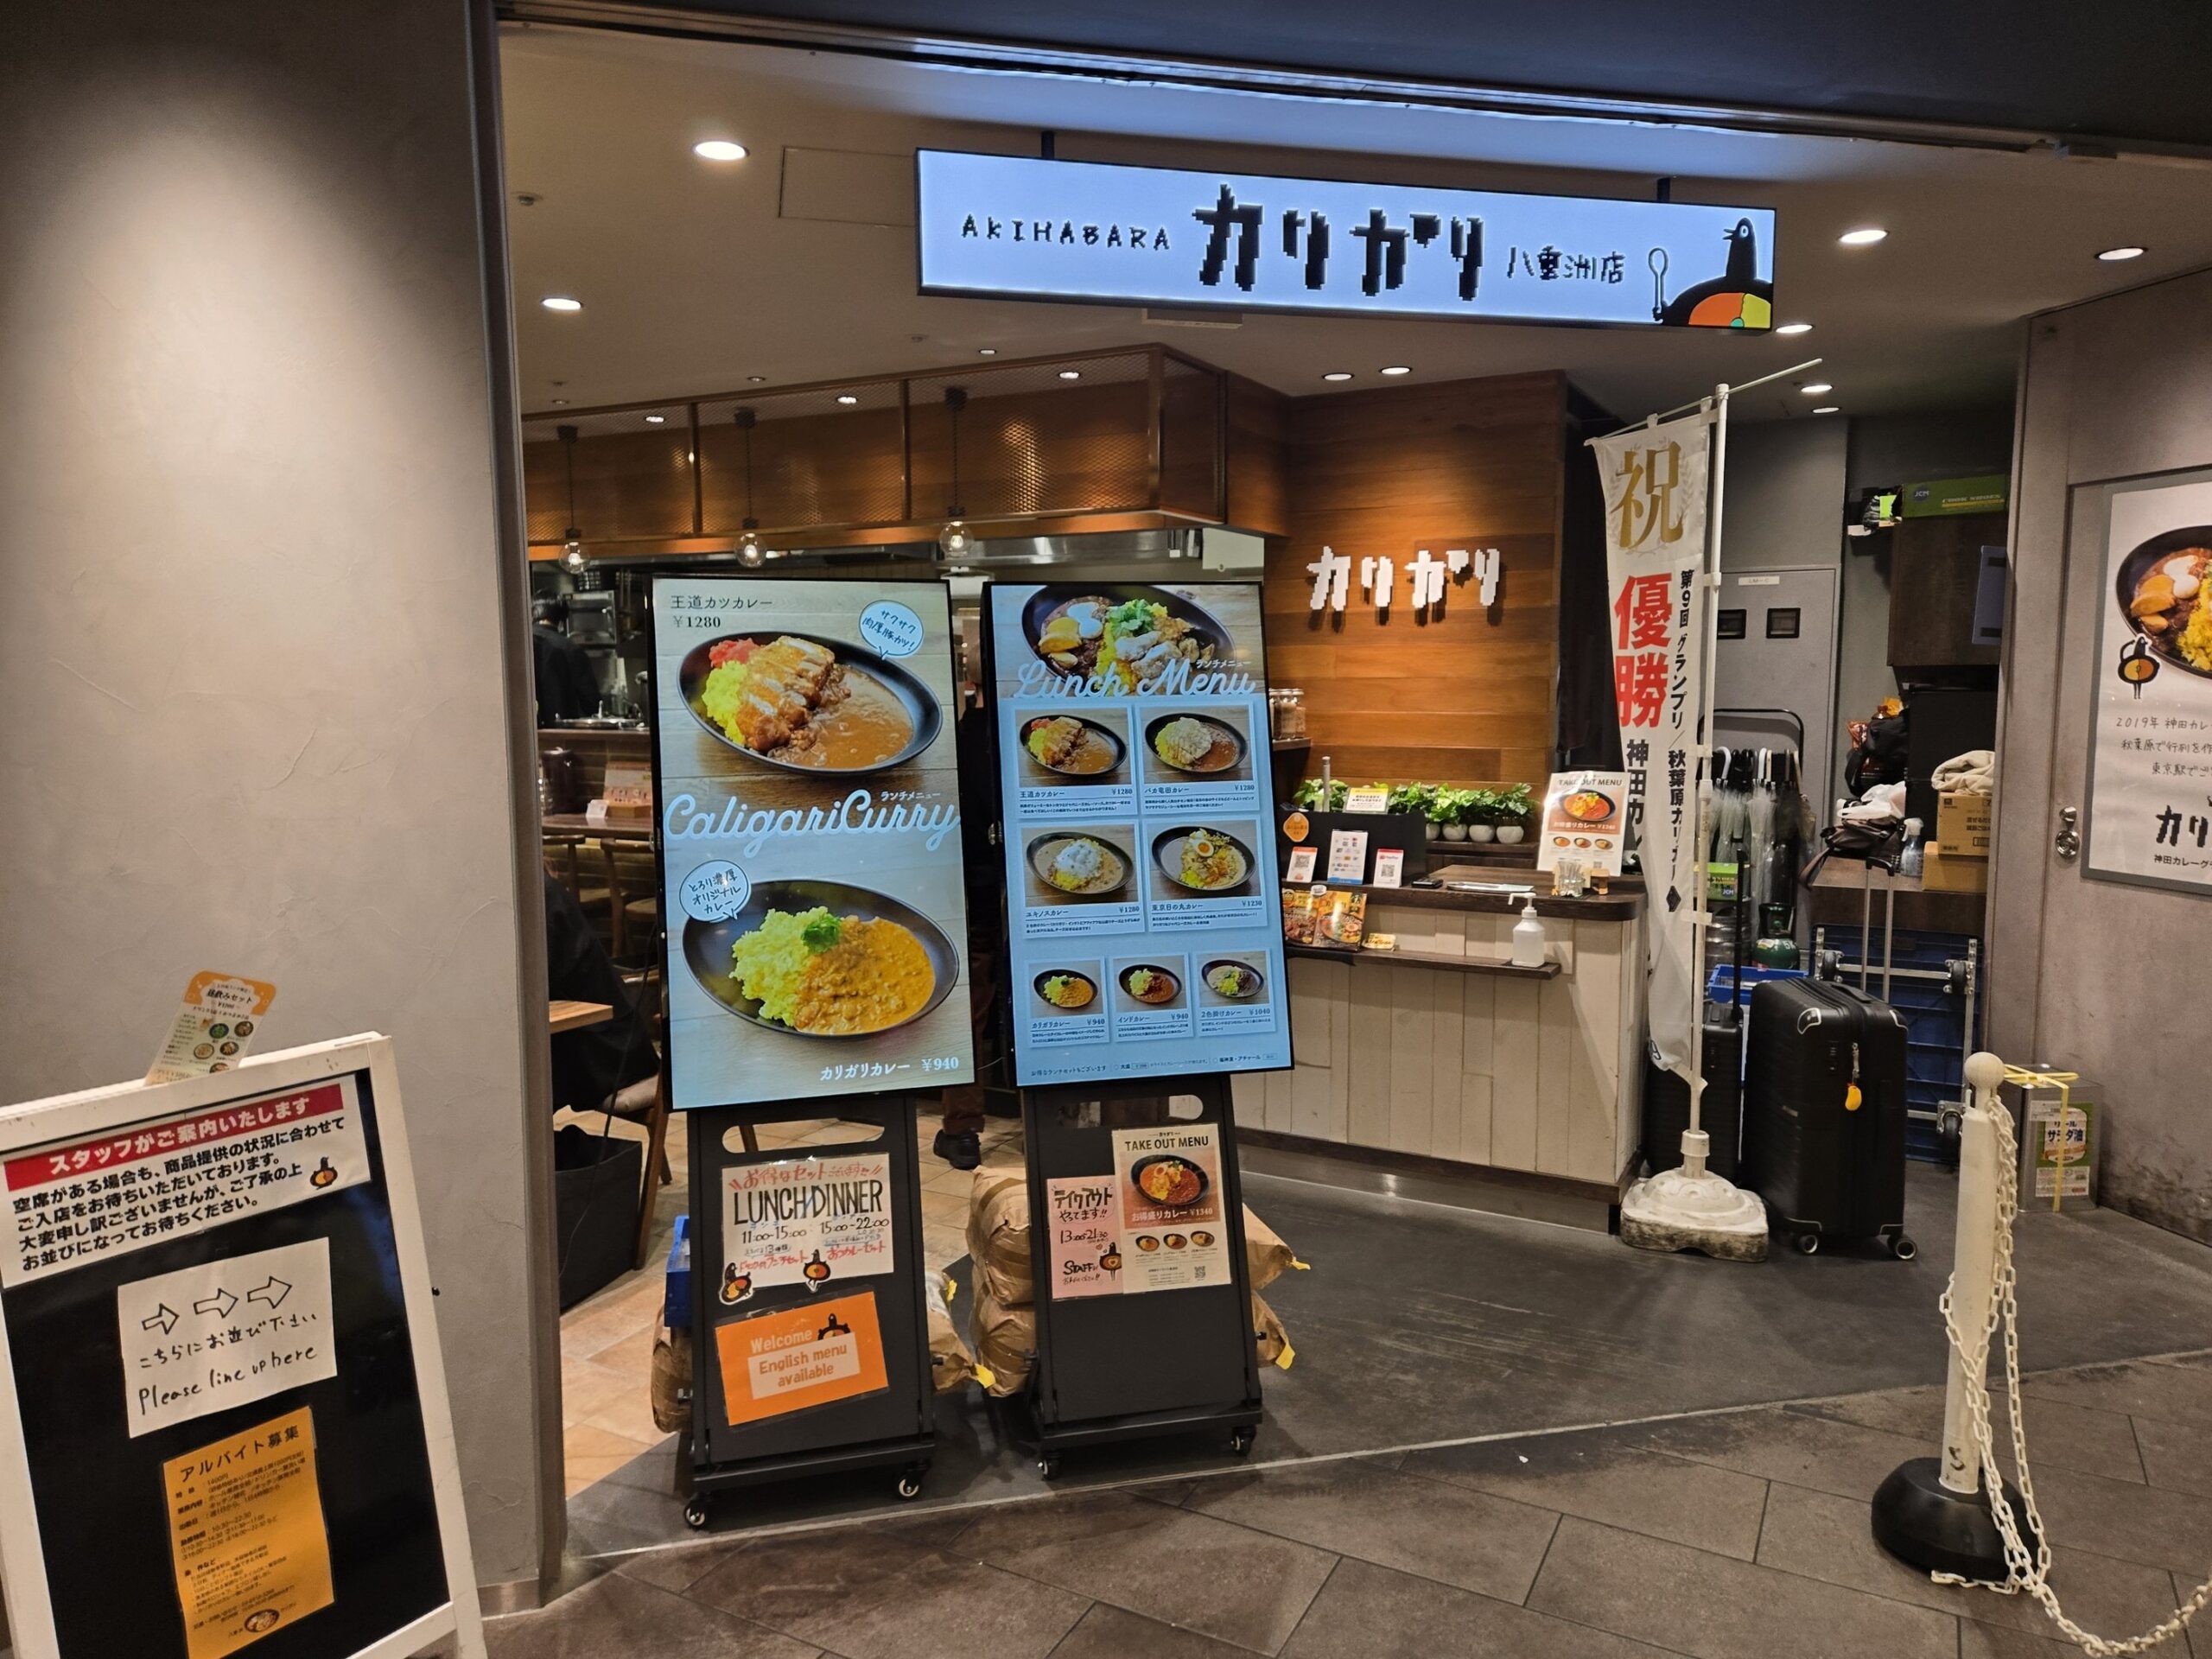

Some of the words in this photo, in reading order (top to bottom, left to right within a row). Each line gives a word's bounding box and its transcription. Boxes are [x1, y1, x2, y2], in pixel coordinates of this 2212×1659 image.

[961, 214, 1171, 251] AKIHABARA
[1506, 245, 1625, 284] 八重洲店
[1611, 441, 1684, 550] 祝
[671, 594, 773, 610] 王道カツカレー
[672, 615, 721, 629] ¥1280
[881, 610, 916, 633] サクサク
[1614, 573, 1673, 728] 優勝
[1014, 660, 1130, 698] Lunch
[1137, 658, 1255, 698] Menu
[2116, 715, 2159, 728] 2019年
[2164, 717, 2212, 730] 神田カレ
[880, 790, 941, 801] ランチメニュー
[2154, 855, 2212, 868] 神田カレーグ
[692, 887, 741, 906] オリジナル
[703, 899, 733, 914] カレー
[1152, 903, 1203, 912] 東京日の丸カレー
[819, 1063, 911, 1082] カリガリカレー
[920, 1056, 959, 1071] ¥940
[49, 1096, 310, 1175] スタッフがご案内いたします
[1125, 1140, 1152, 1152] TAKE
[1154, 1138, 1176, 1149] OUT
[1178, 1135, 1209, 1147] MENU
[17, 1154, 280, 1232] ご入店をお待ちいただいております。
[1054, 1187, 1113, 1209] テイクアウト
[22, 1197, 259, 1271] お並びになってお待ちください。
[140, 1313, 317, 1369] こちらにお並び下さい
[750, 1329, 813, 1354] Welcome
[759, 1351, 809, 1375] English
[812, 1344, 848, 1361] menu
[778, 1363, 834, 1388] available
[139, 1383, 202, 1415] Please
[209, 1369, 245, 1389] line
[181, 1425, 299, 1483] アルバイト募集
